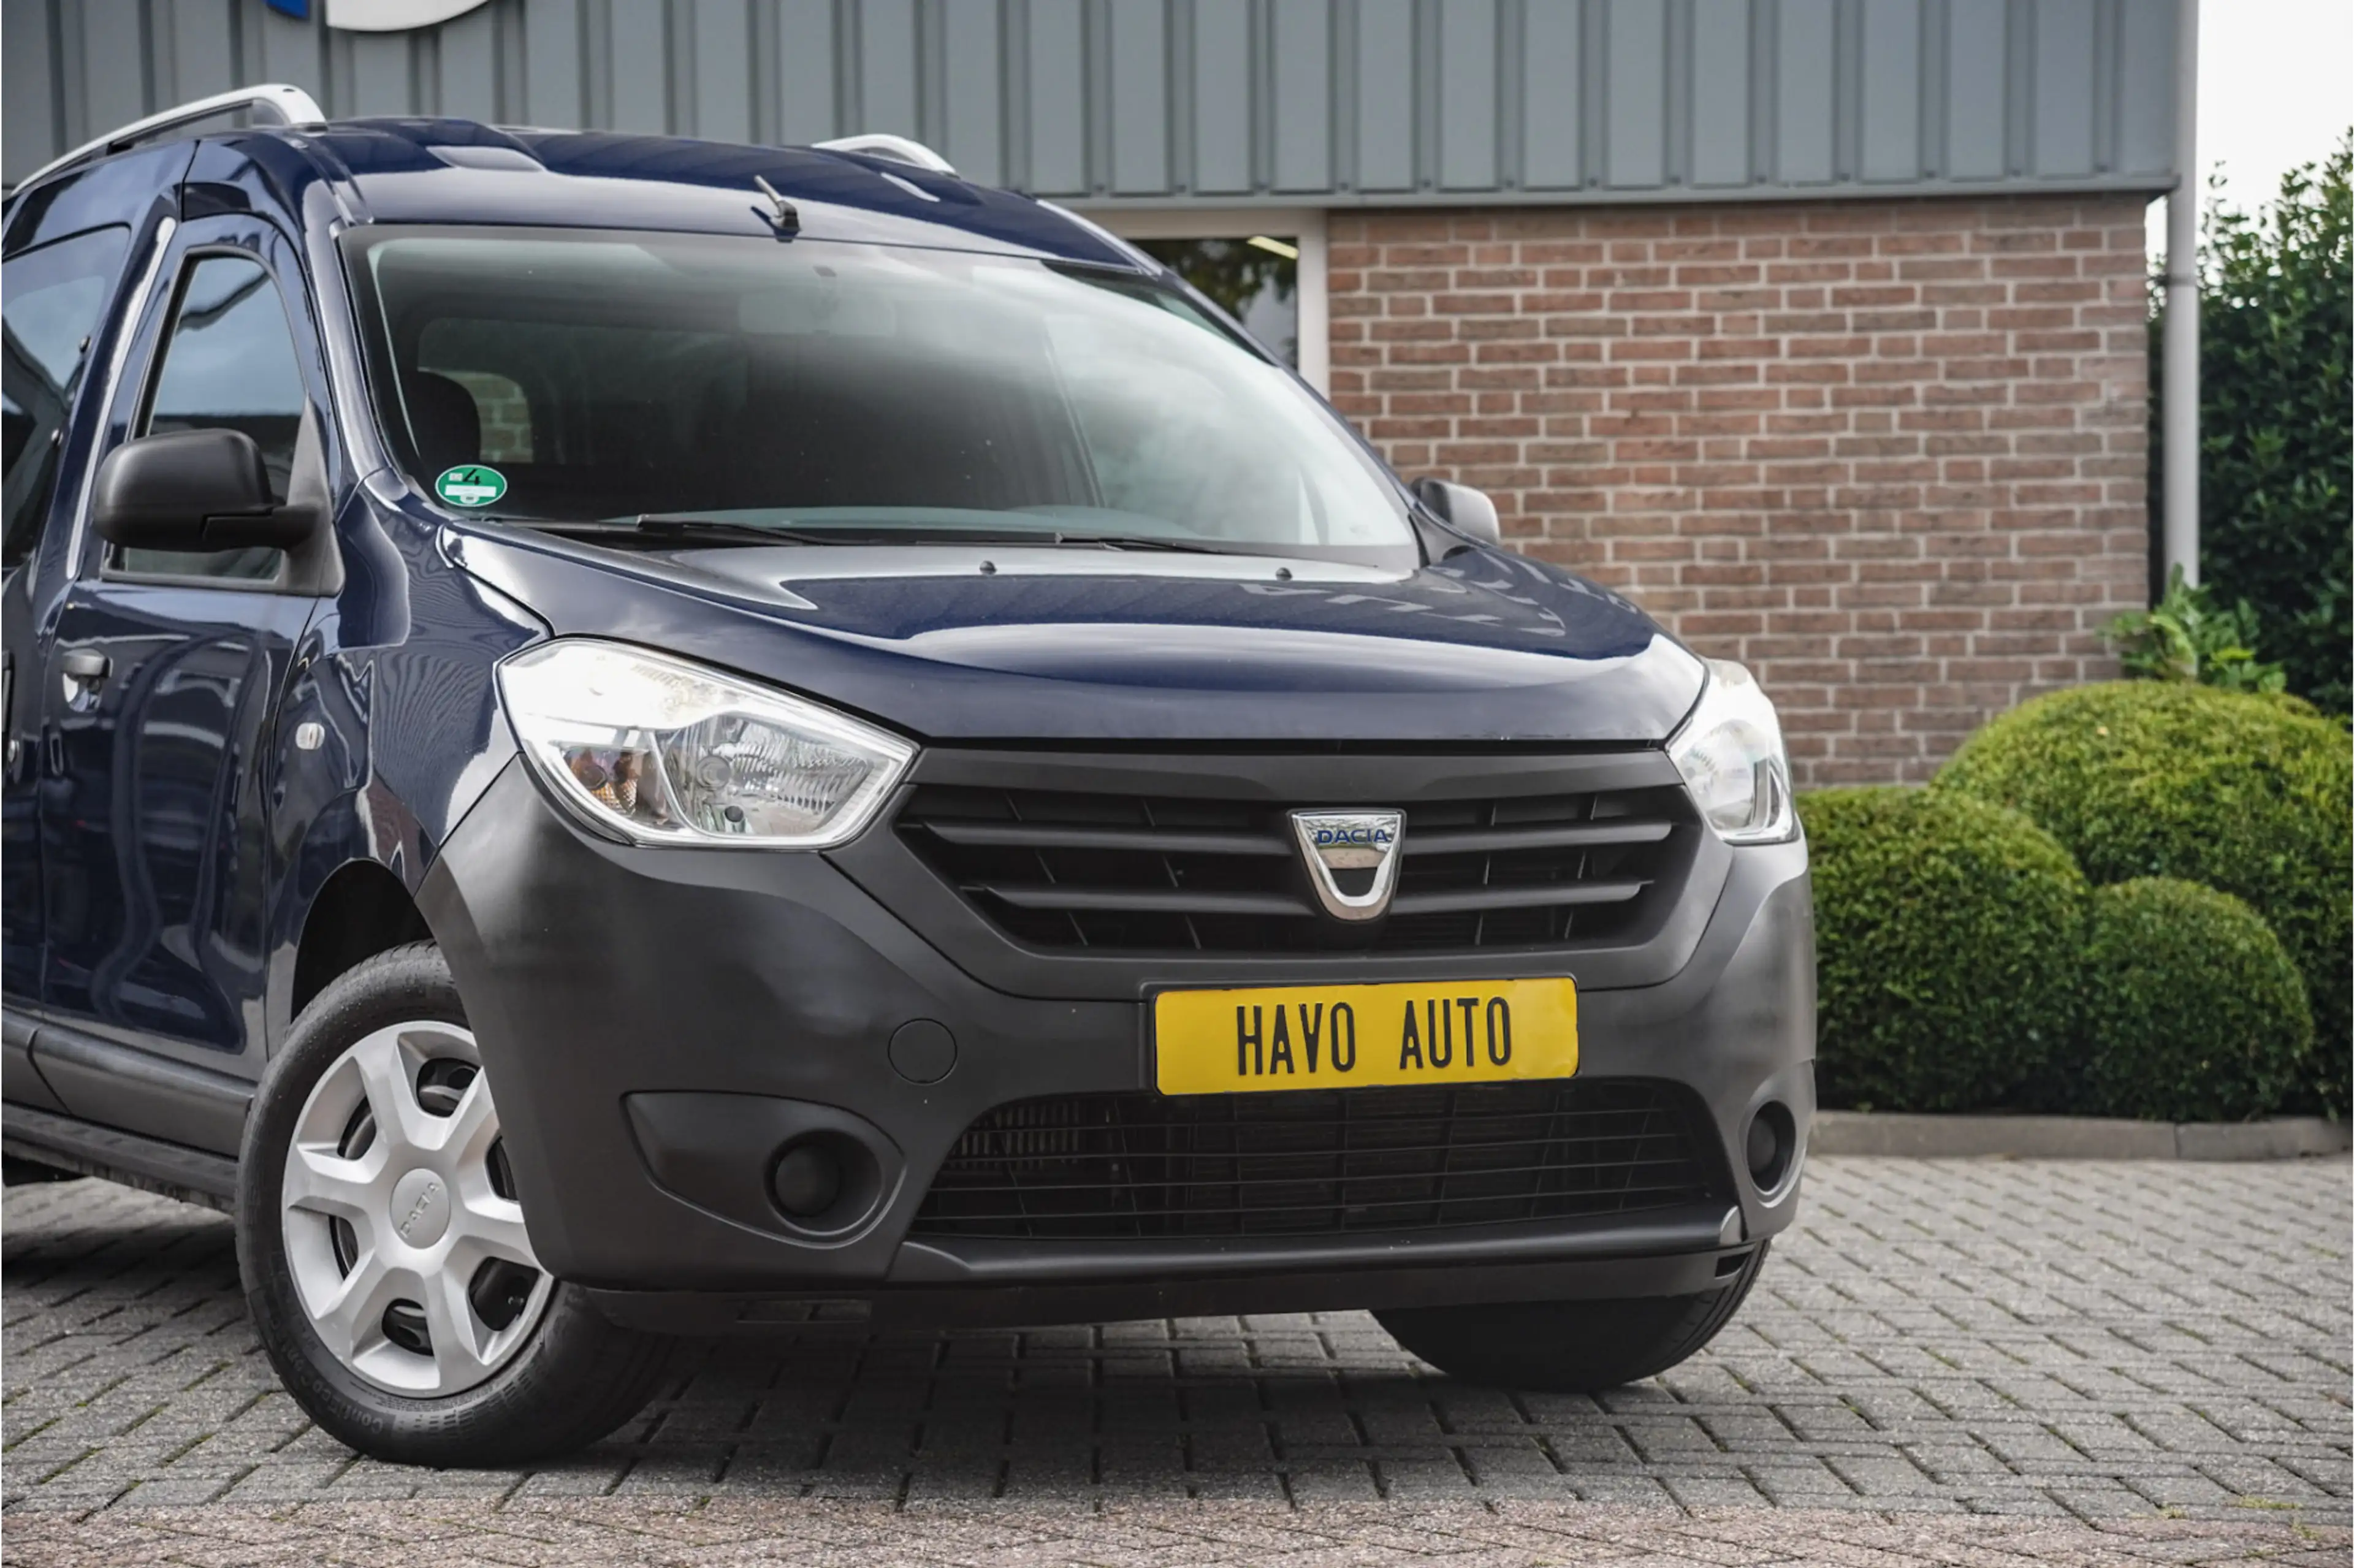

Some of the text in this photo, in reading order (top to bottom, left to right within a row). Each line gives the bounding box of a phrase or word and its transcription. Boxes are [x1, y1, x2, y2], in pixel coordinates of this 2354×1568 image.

[462, 468, 481, 485] 4
[1317, 829, 1388, 843] DACIA
[1236, 997, 1511, 1076] HAVO AUTO
